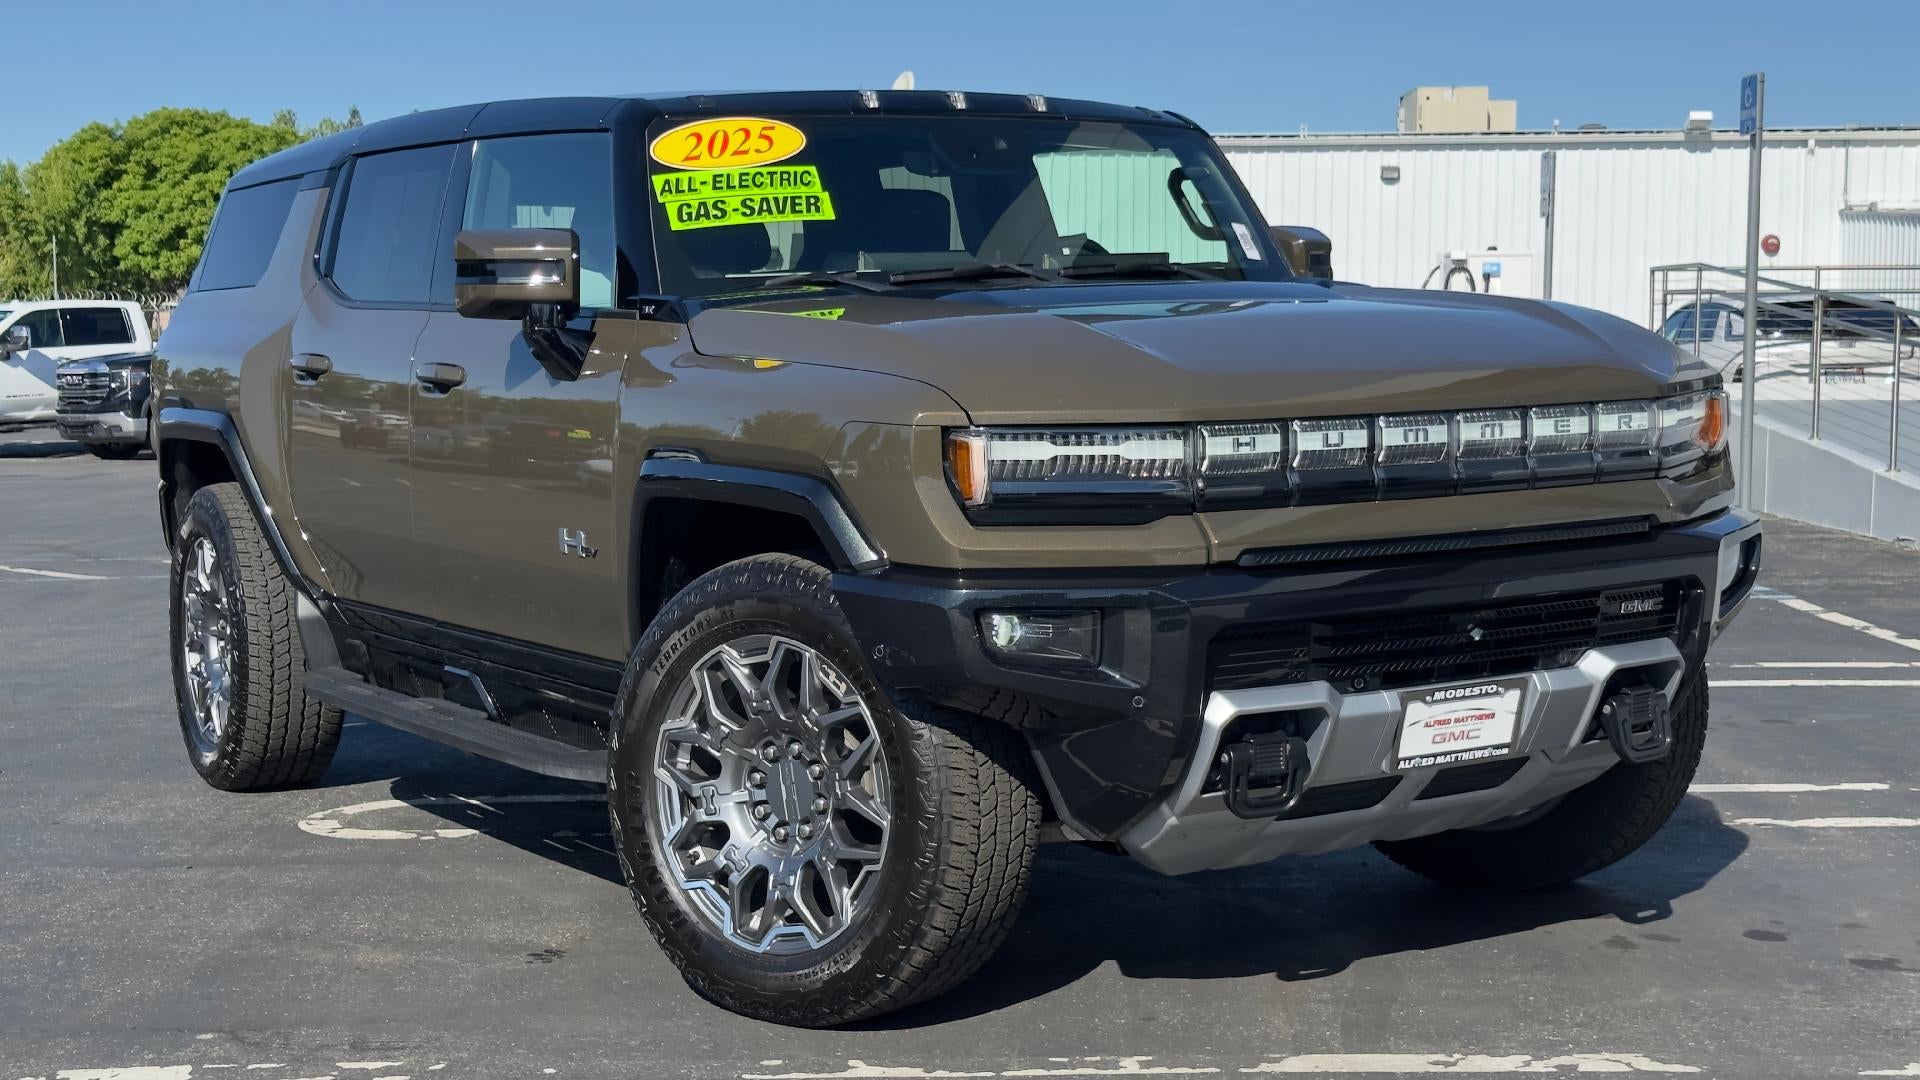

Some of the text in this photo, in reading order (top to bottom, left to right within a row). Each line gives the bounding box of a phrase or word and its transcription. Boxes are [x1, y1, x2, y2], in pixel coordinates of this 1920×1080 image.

[682, 126, 775, 162] 2025
[660, 171, 813, 196] ALL-ELECTRIC
[677, 195, 821, 223] GAS-SAVER
[1232, 414, 1633, 452] HUMMER
[1621, 597, 1664, 614] GMC
[655, 615, 711, 676] TERRITORY
[1433, 684, 1498, 701] MODESTO
[1423, 718, 1452, 728] ALFRED
[1453, 712, 1496, 724] MATTHEWS
[1431, 728, 1481, 744] GMC
